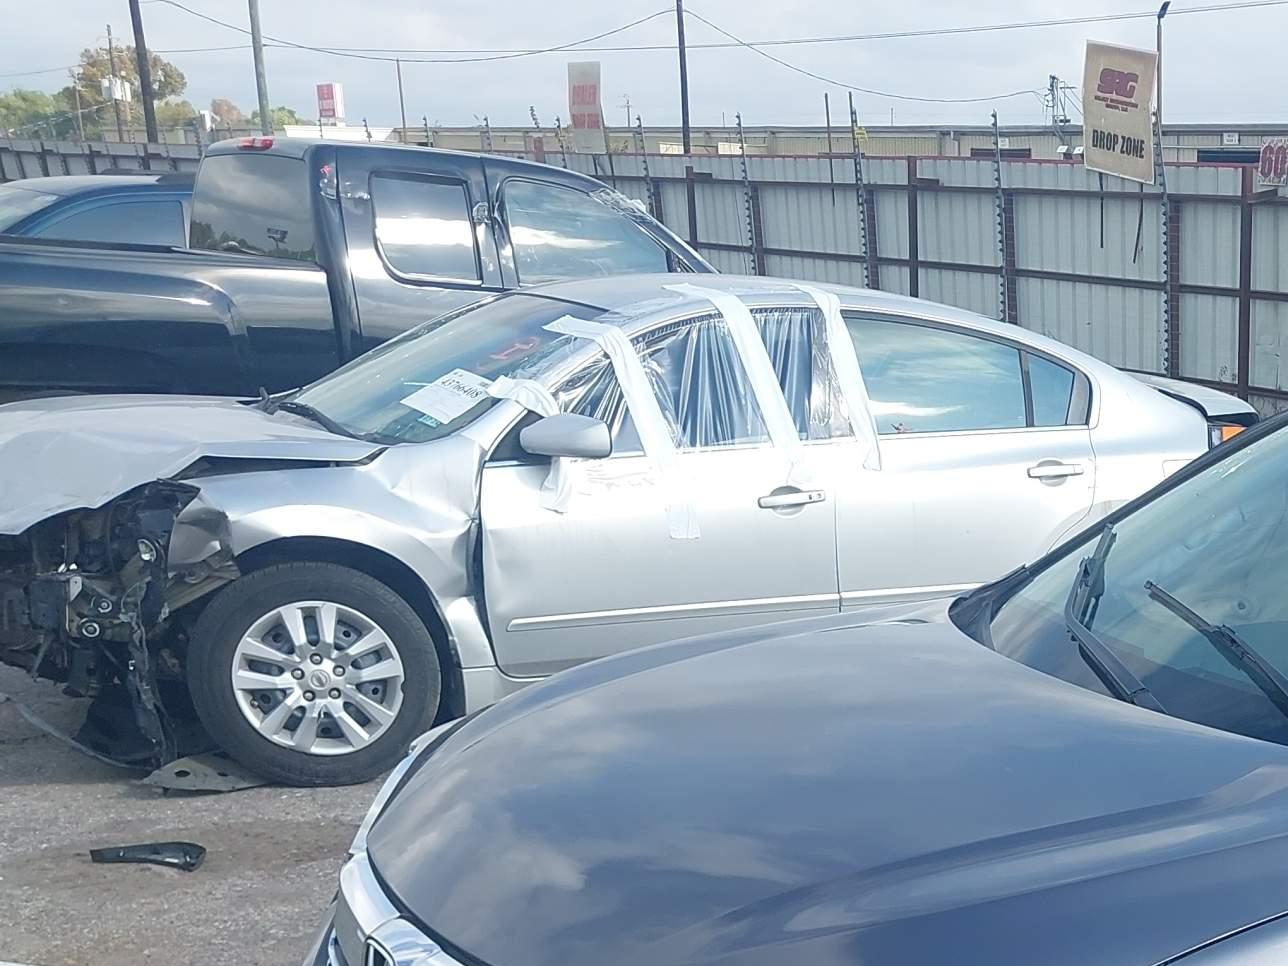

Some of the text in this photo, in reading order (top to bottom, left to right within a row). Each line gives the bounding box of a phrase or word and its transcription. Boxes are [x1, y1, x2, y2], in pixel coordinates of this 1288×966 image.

[1092, 129, 1145, 159] DROP ZONE
[1261, 145, 1287, 178] 60
